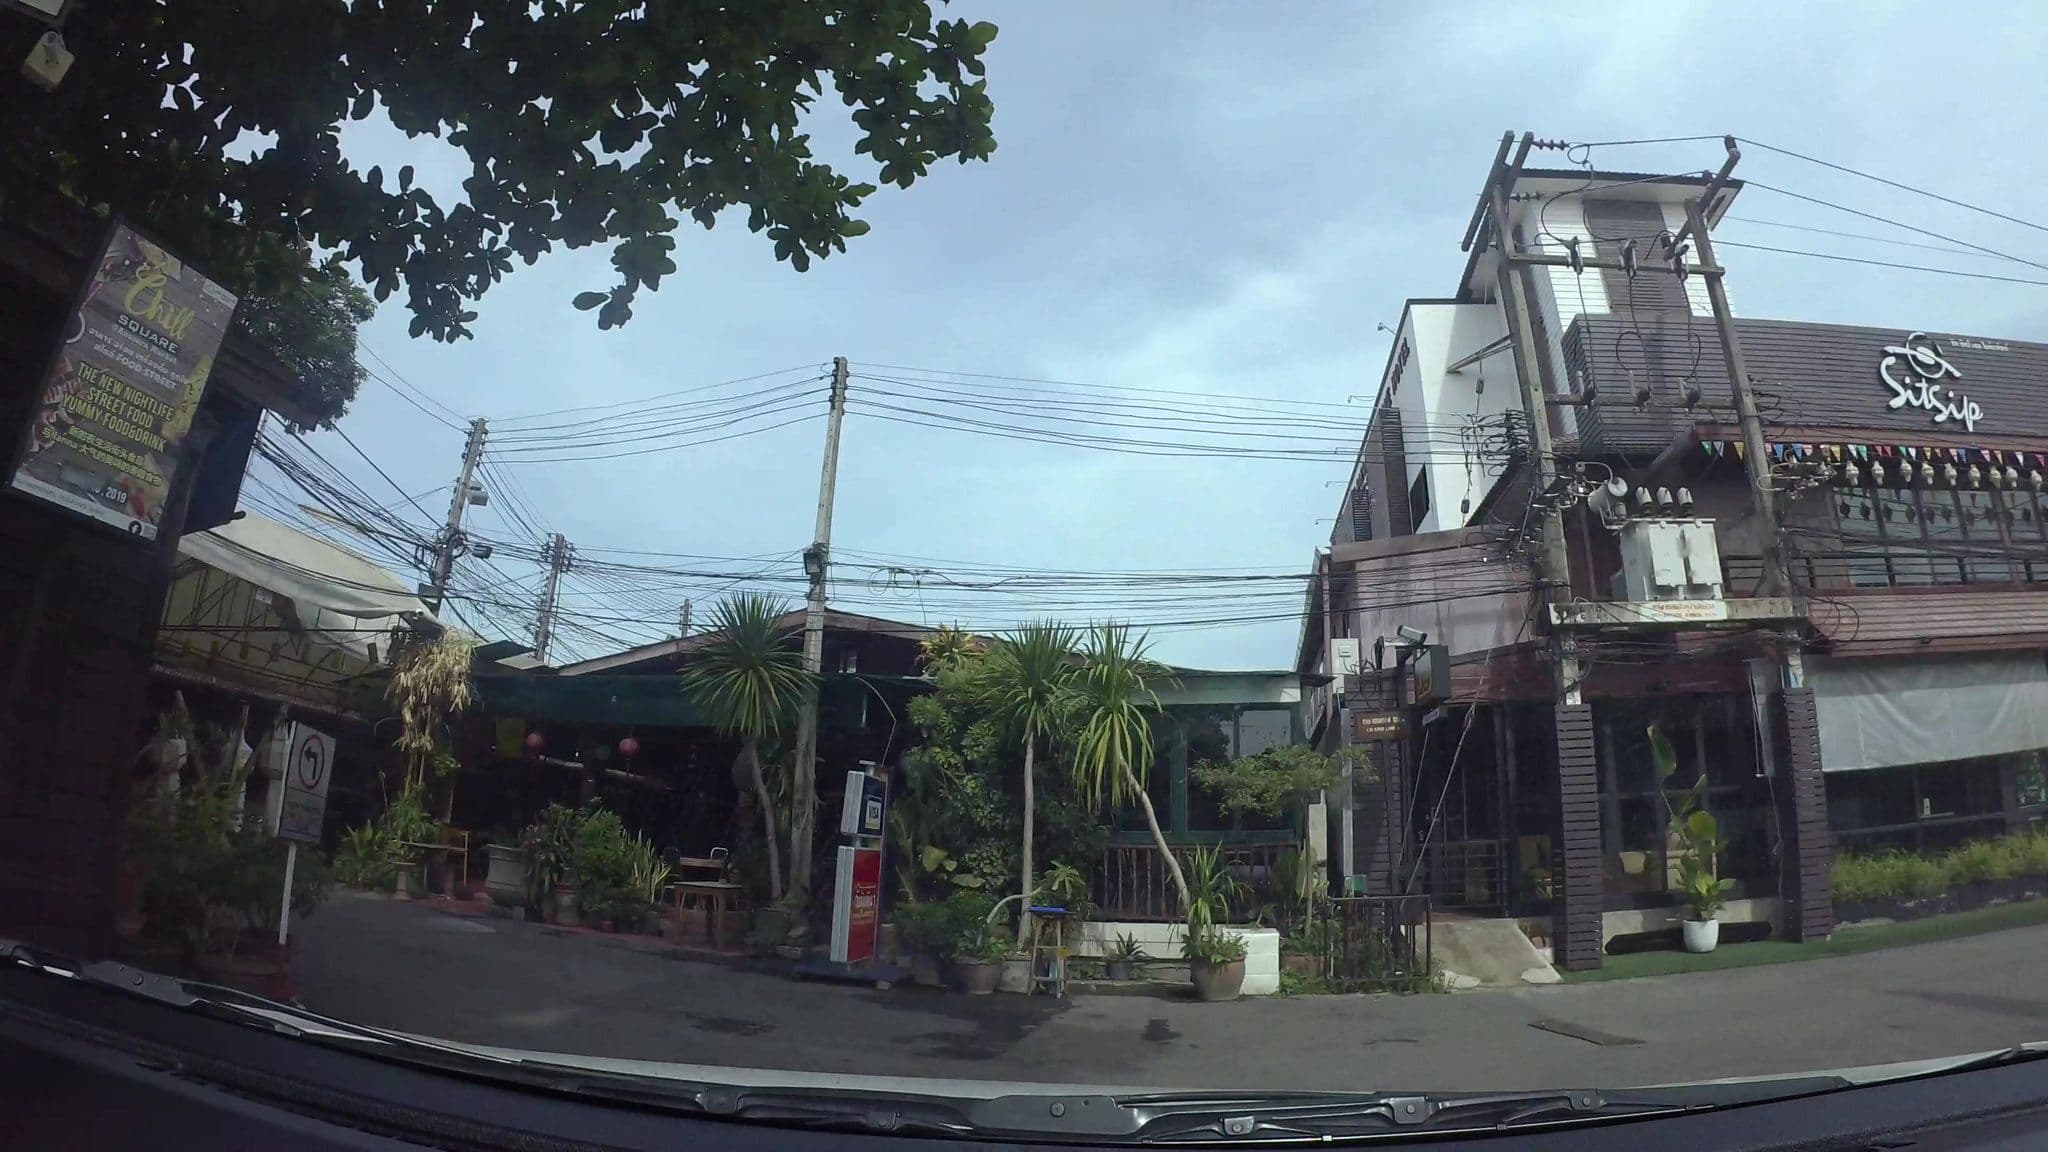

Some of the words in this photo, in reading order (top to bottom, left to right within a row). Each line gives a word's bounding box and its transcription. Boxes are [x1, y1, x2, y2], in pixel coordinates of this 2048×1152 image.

[125, 262, 195, 341] Chill
[118, 314, 178, 354] SQUARE
[75, 362, 98, 383] THE
[97, 373, 125, 397] NEW
[122, 385, 175, 422] NIGHTLIFE
[85, 386, 128, 417] STREET
[124, 405, 154, 430] FOOD
[59, 392, 104, 424] YUMMY
[100, 411, 167, 453] FOOD&DRINK
[104, 486, 128, 505] 2019
